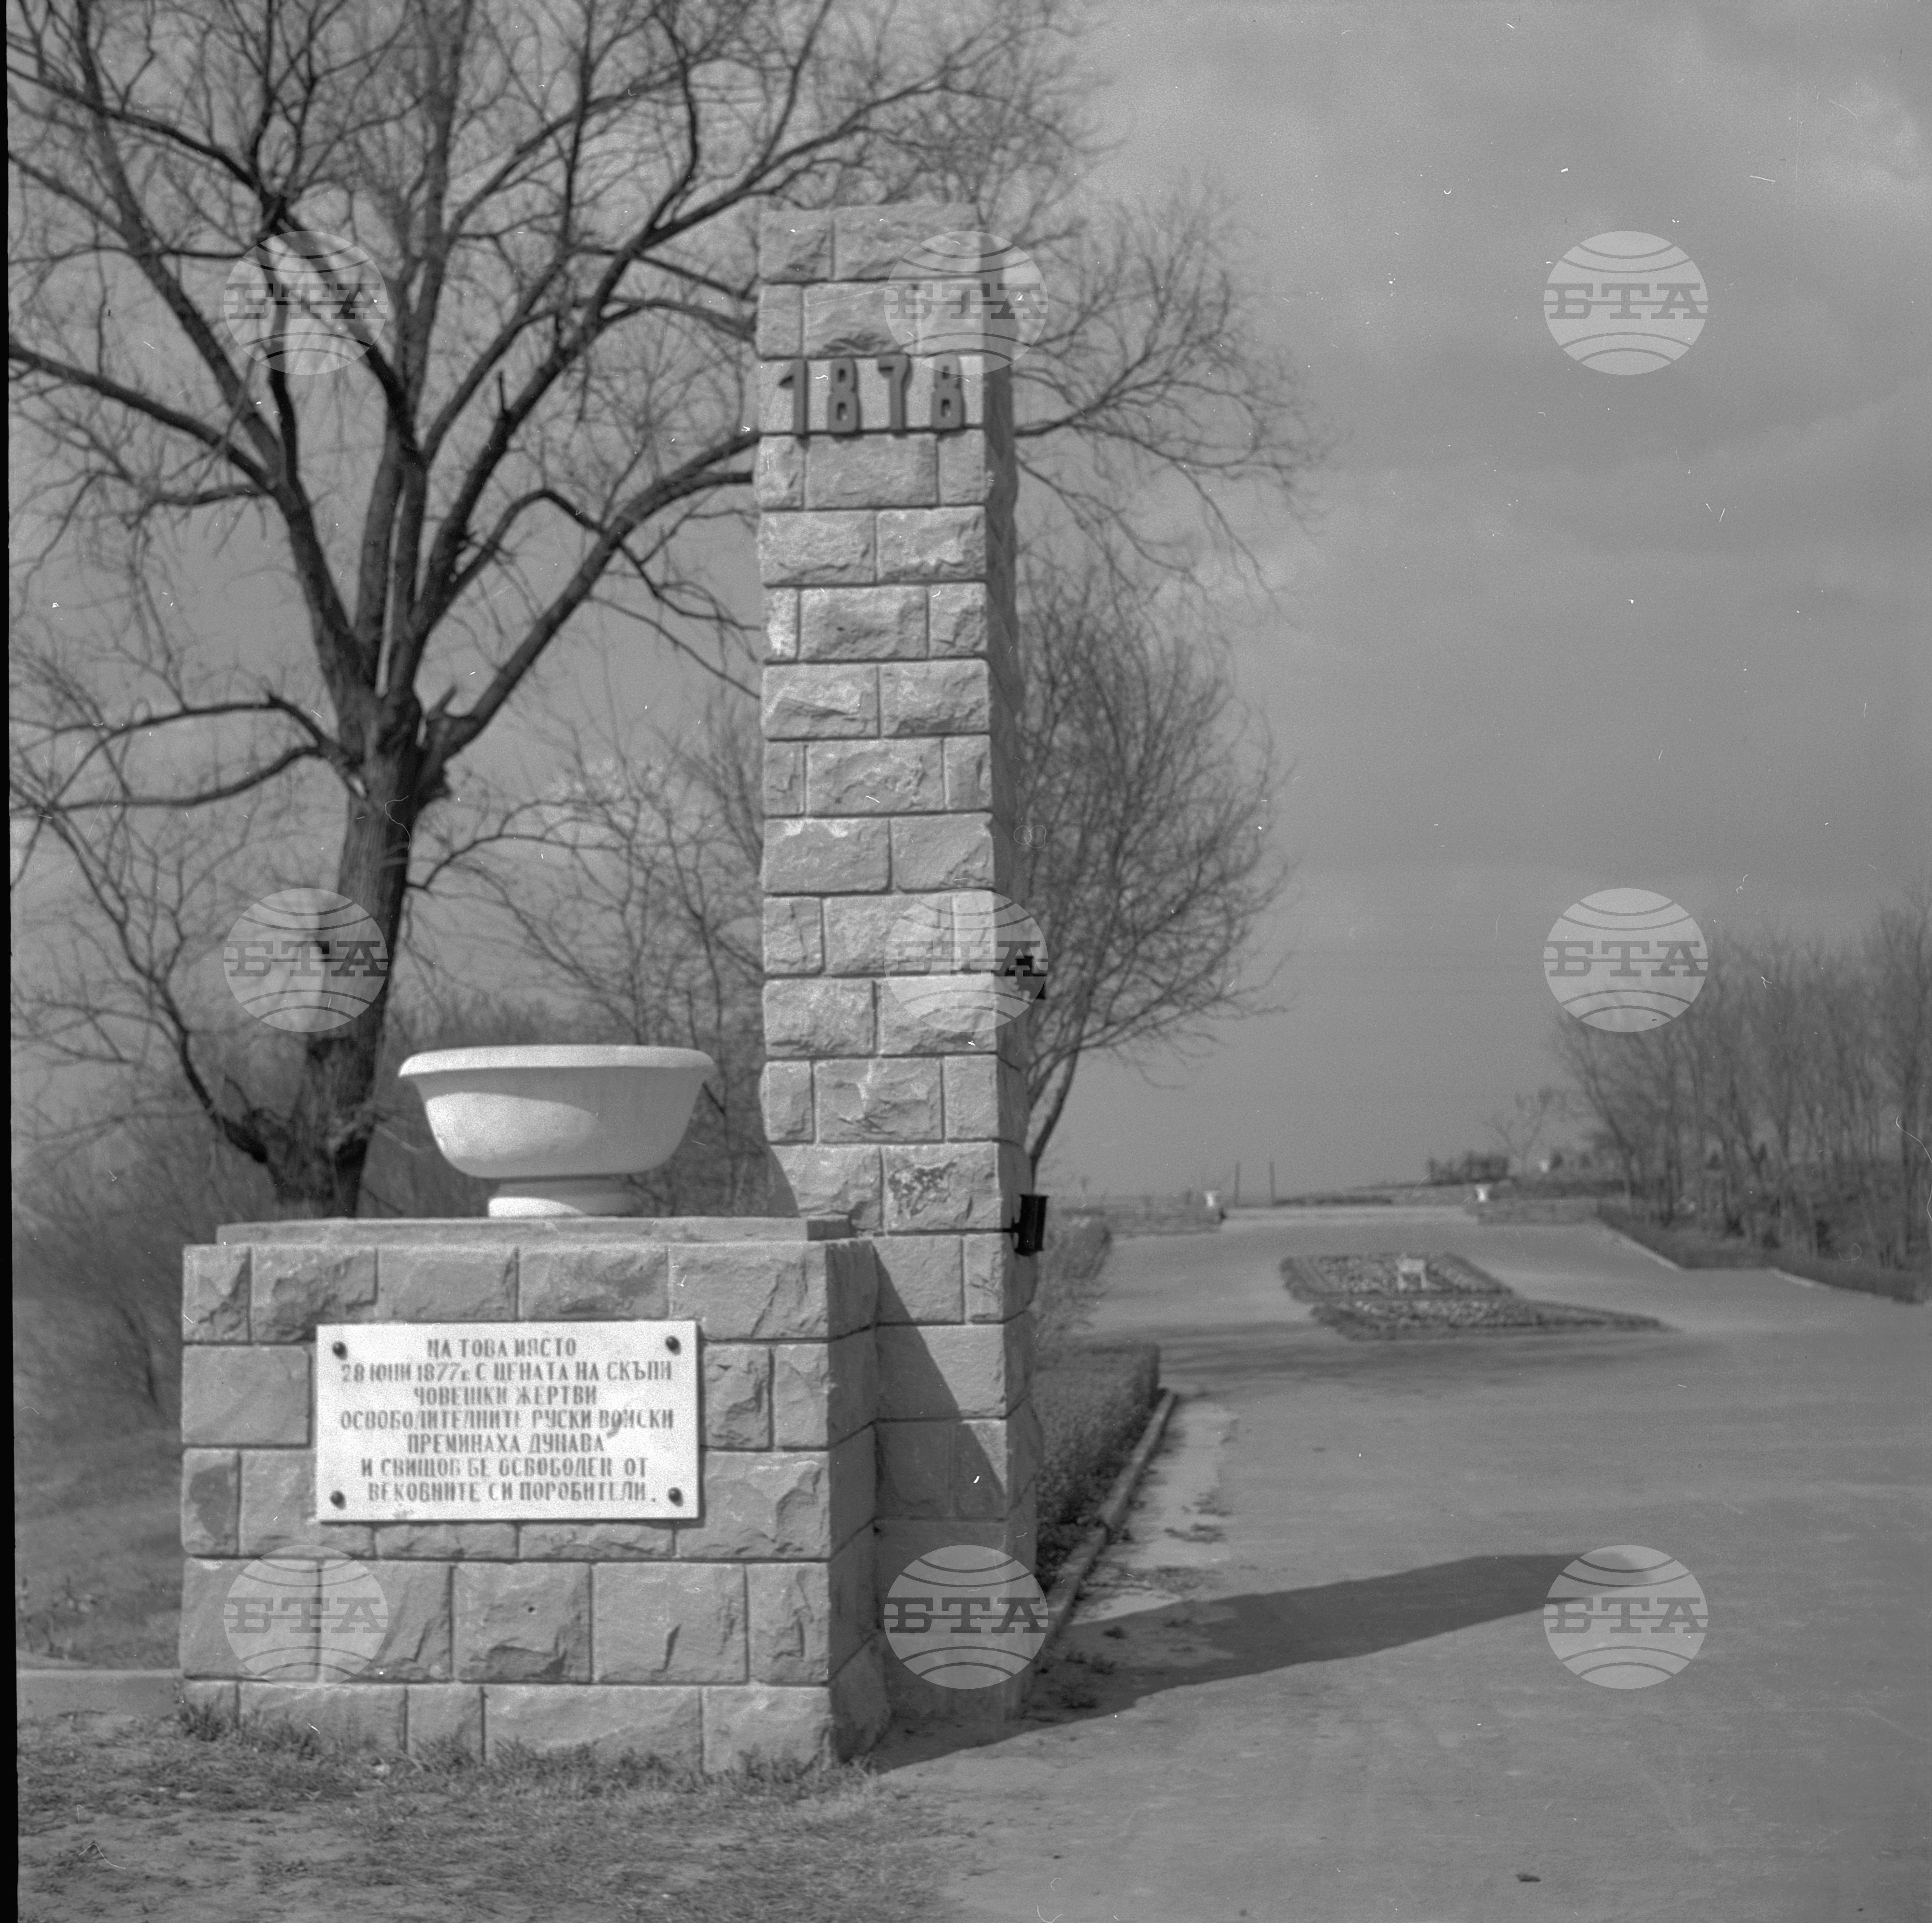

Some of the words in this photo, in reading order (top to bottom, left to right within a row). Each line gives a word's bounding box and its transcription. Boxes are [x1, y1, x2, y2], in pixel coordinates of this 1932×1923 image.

[779, 355, 966, 434] 1878
[427, 1339, 452, 1358] НА
[459, 1339, 508, 1357] ТОВА
[341, 1363, 365, 1382] 28
[475, 1362, 486, 1381] С
[494, 1361, 568, 1381] ЦЕНАТА
[575, 1361, 599, 1381] НА
[607, 1360, 672, 1380] СКЪПИ
[414, 1386, 508, 1406] ЧОВЕШКИ
[516, 1385, 597, 1405] ЖЕРТВИ
[532, 1409, 592, 1429] РУСКИ
[407, 1433, 522, 1454] ПРЕМИНАХА
[529, 1433, 604, 1453] ДУНАВА
[361, 1457, 373, 1477] И
[467, 1457, 490, 1477] БЕ
[498, 1457, 612, 1477] ОСВОБОДЕН
[625, 1457, 648, 1477] ОТ
[368, 1482, 481, 1502] ВЕКОВНИТЕ
[488, 1481, 512, 1501] СИ
